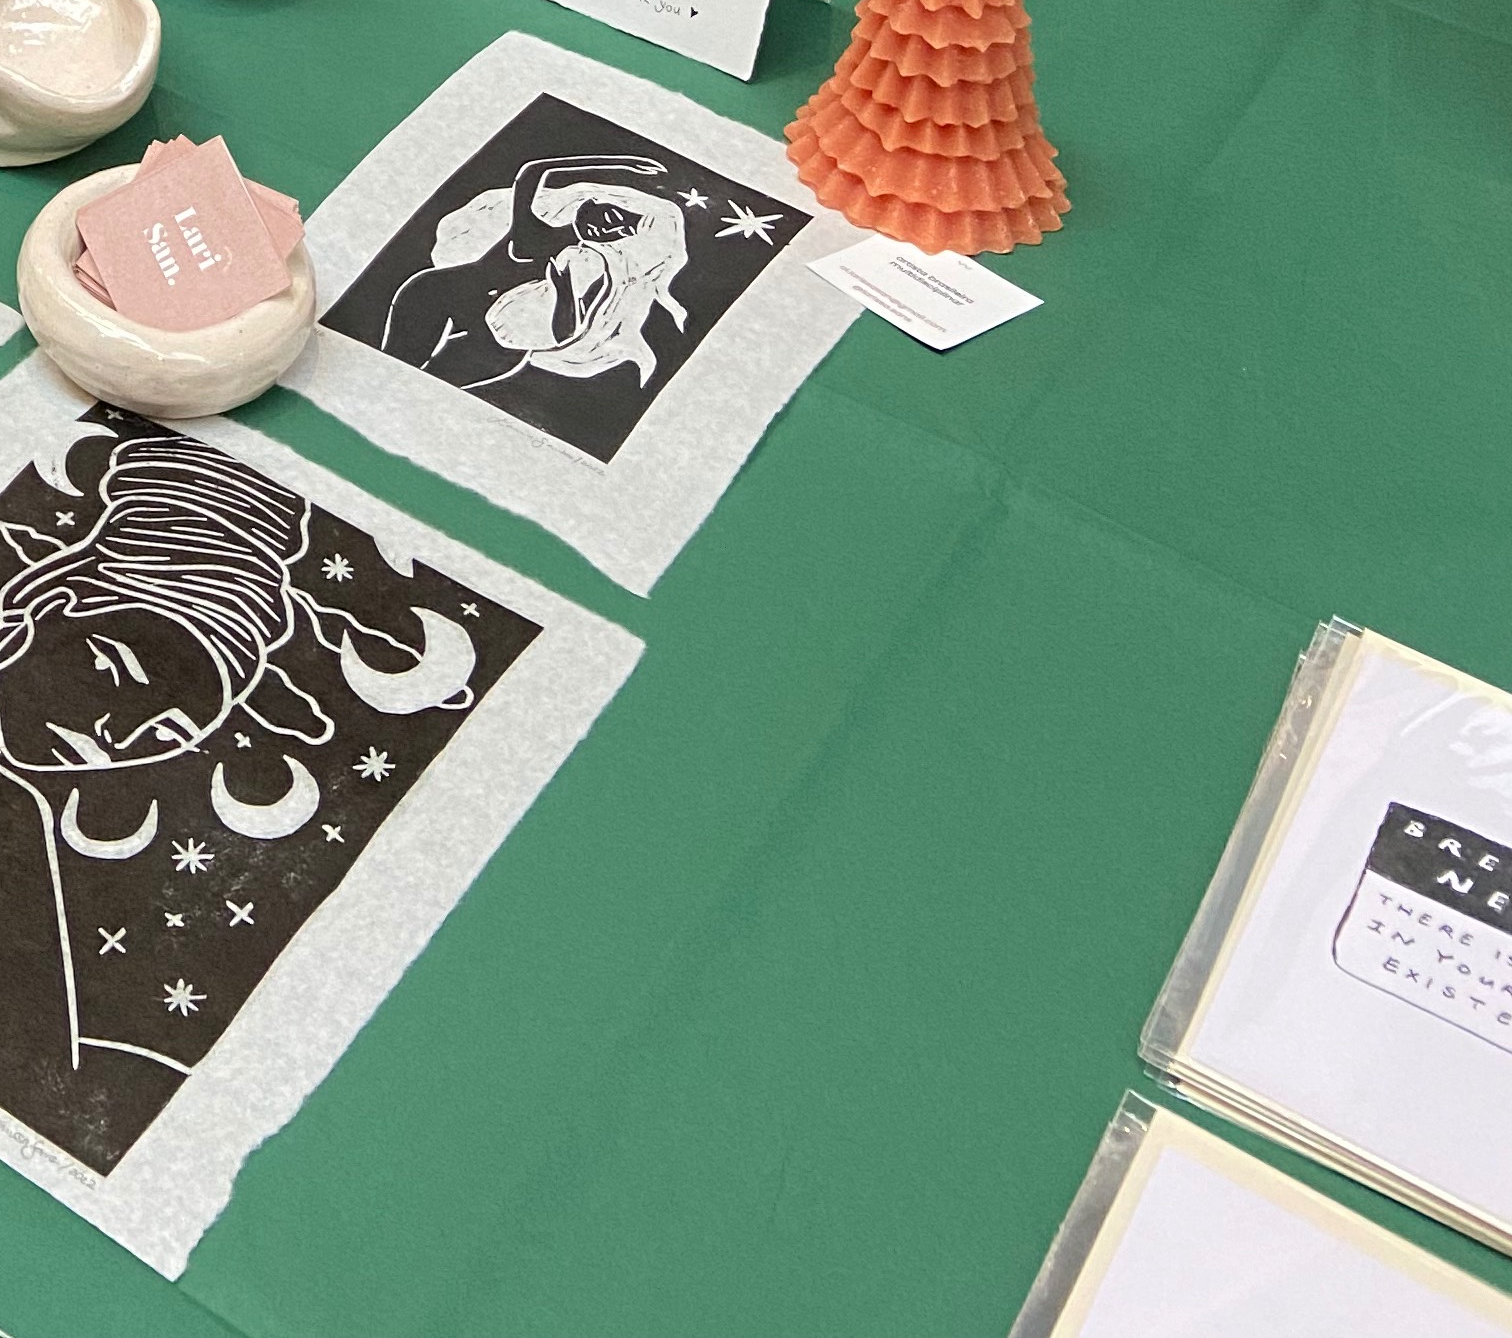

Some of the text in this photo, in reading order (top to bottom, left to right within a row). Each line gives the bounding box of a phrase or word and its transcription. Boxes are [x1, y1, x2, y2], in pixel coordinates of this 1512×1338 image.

[654, 0, 681, 16] you
[173, 206, 222, 272] Lari
[1367, 919, 1416, 946] IN
[1379, 893, 1474, 946] THERE
